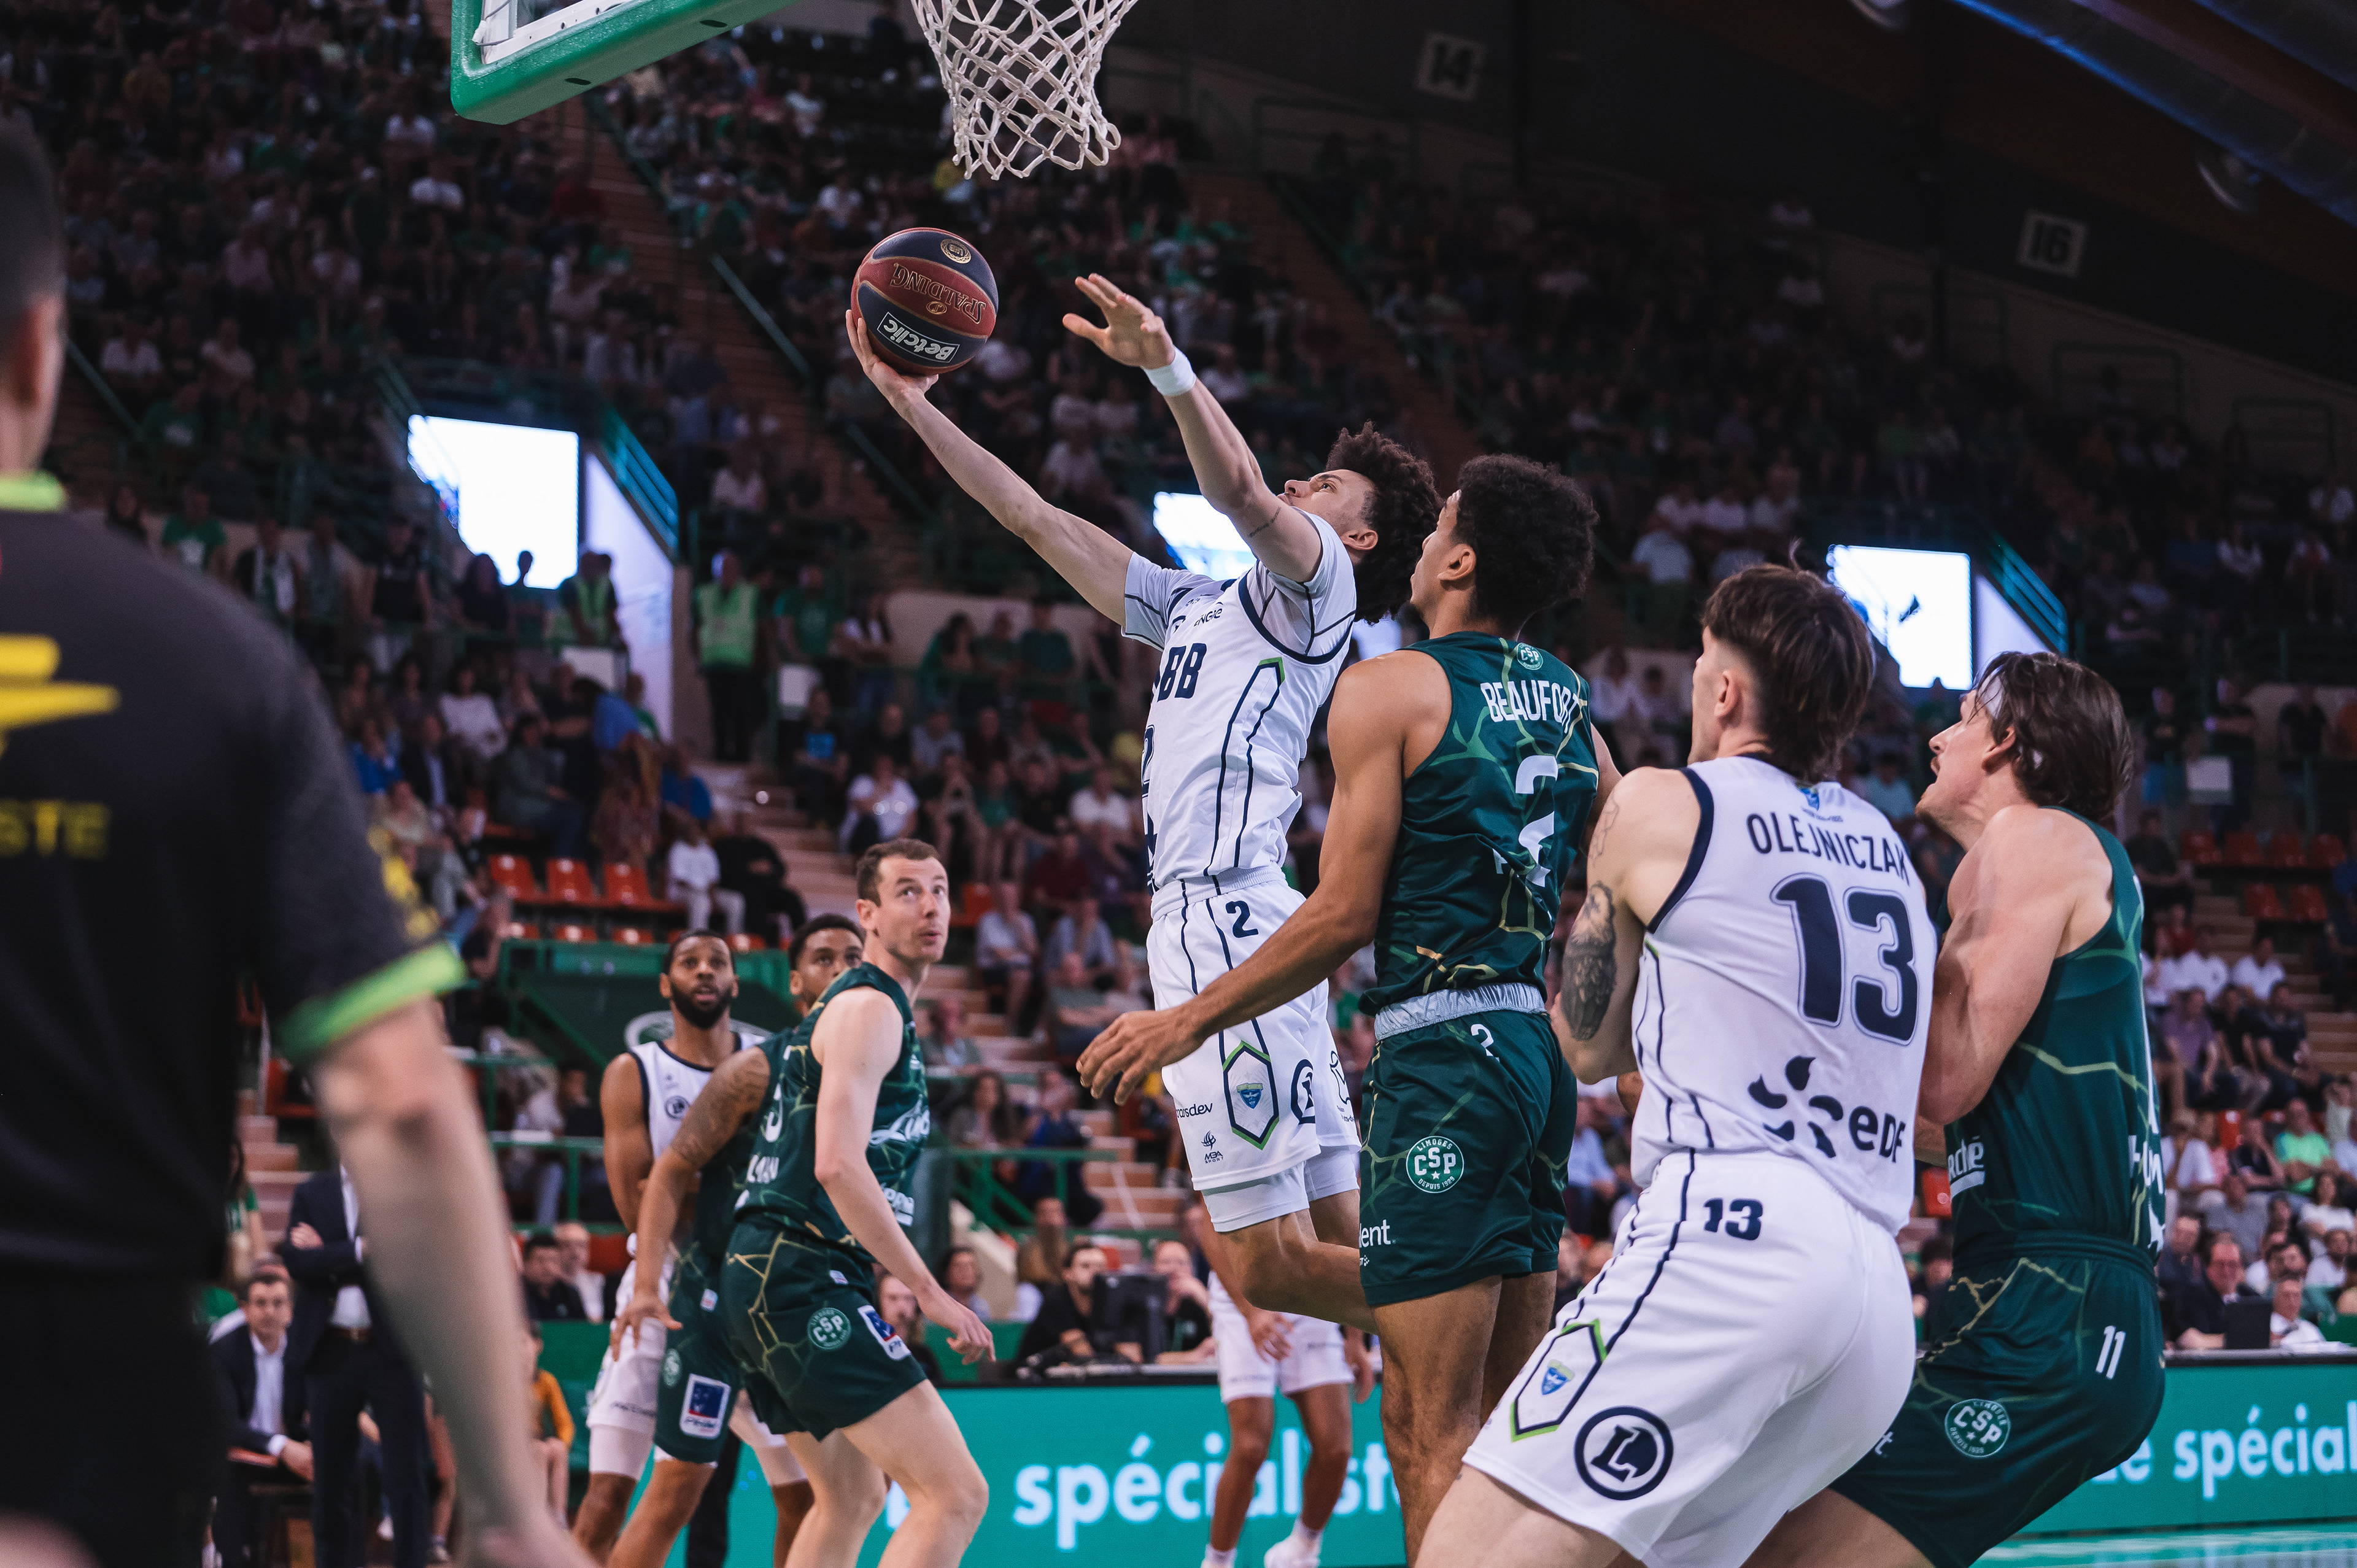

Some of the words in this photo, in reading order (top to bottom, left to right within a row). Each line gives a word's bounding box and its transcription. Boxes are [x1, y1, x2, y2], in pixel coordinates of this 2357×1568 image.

[1431, 42, 1471, 88] 14
[2030, 220, 2072, 264] 16
[891, 263, 986, 324] SPALDING
[884, 319, 956, 361] Betclic
[1520, 647, 1539, 661] CSP
[1480, 679, 1579, 733] BEAUFORT
[1225, 900, 1259, 938] 2
[1770, 872, 1920, 1046] 13
[1414, 1147, 1456, 1176] CSP
[1416, 1138, 1452, 1152] LIMOGES
[1418, 1178, 1440, 1189] DEPUIS
[1441, 1176, 1455, 1188] 1929
[1703, 1197, 1763, 1241] 13
[813, 1315, 844, 1342] CSP
[2096, 1325, 2126, 1380] 11
[1954, 1405, 2002, 1444] CSP
[2173, 1400, 2357, 1500] spécial
